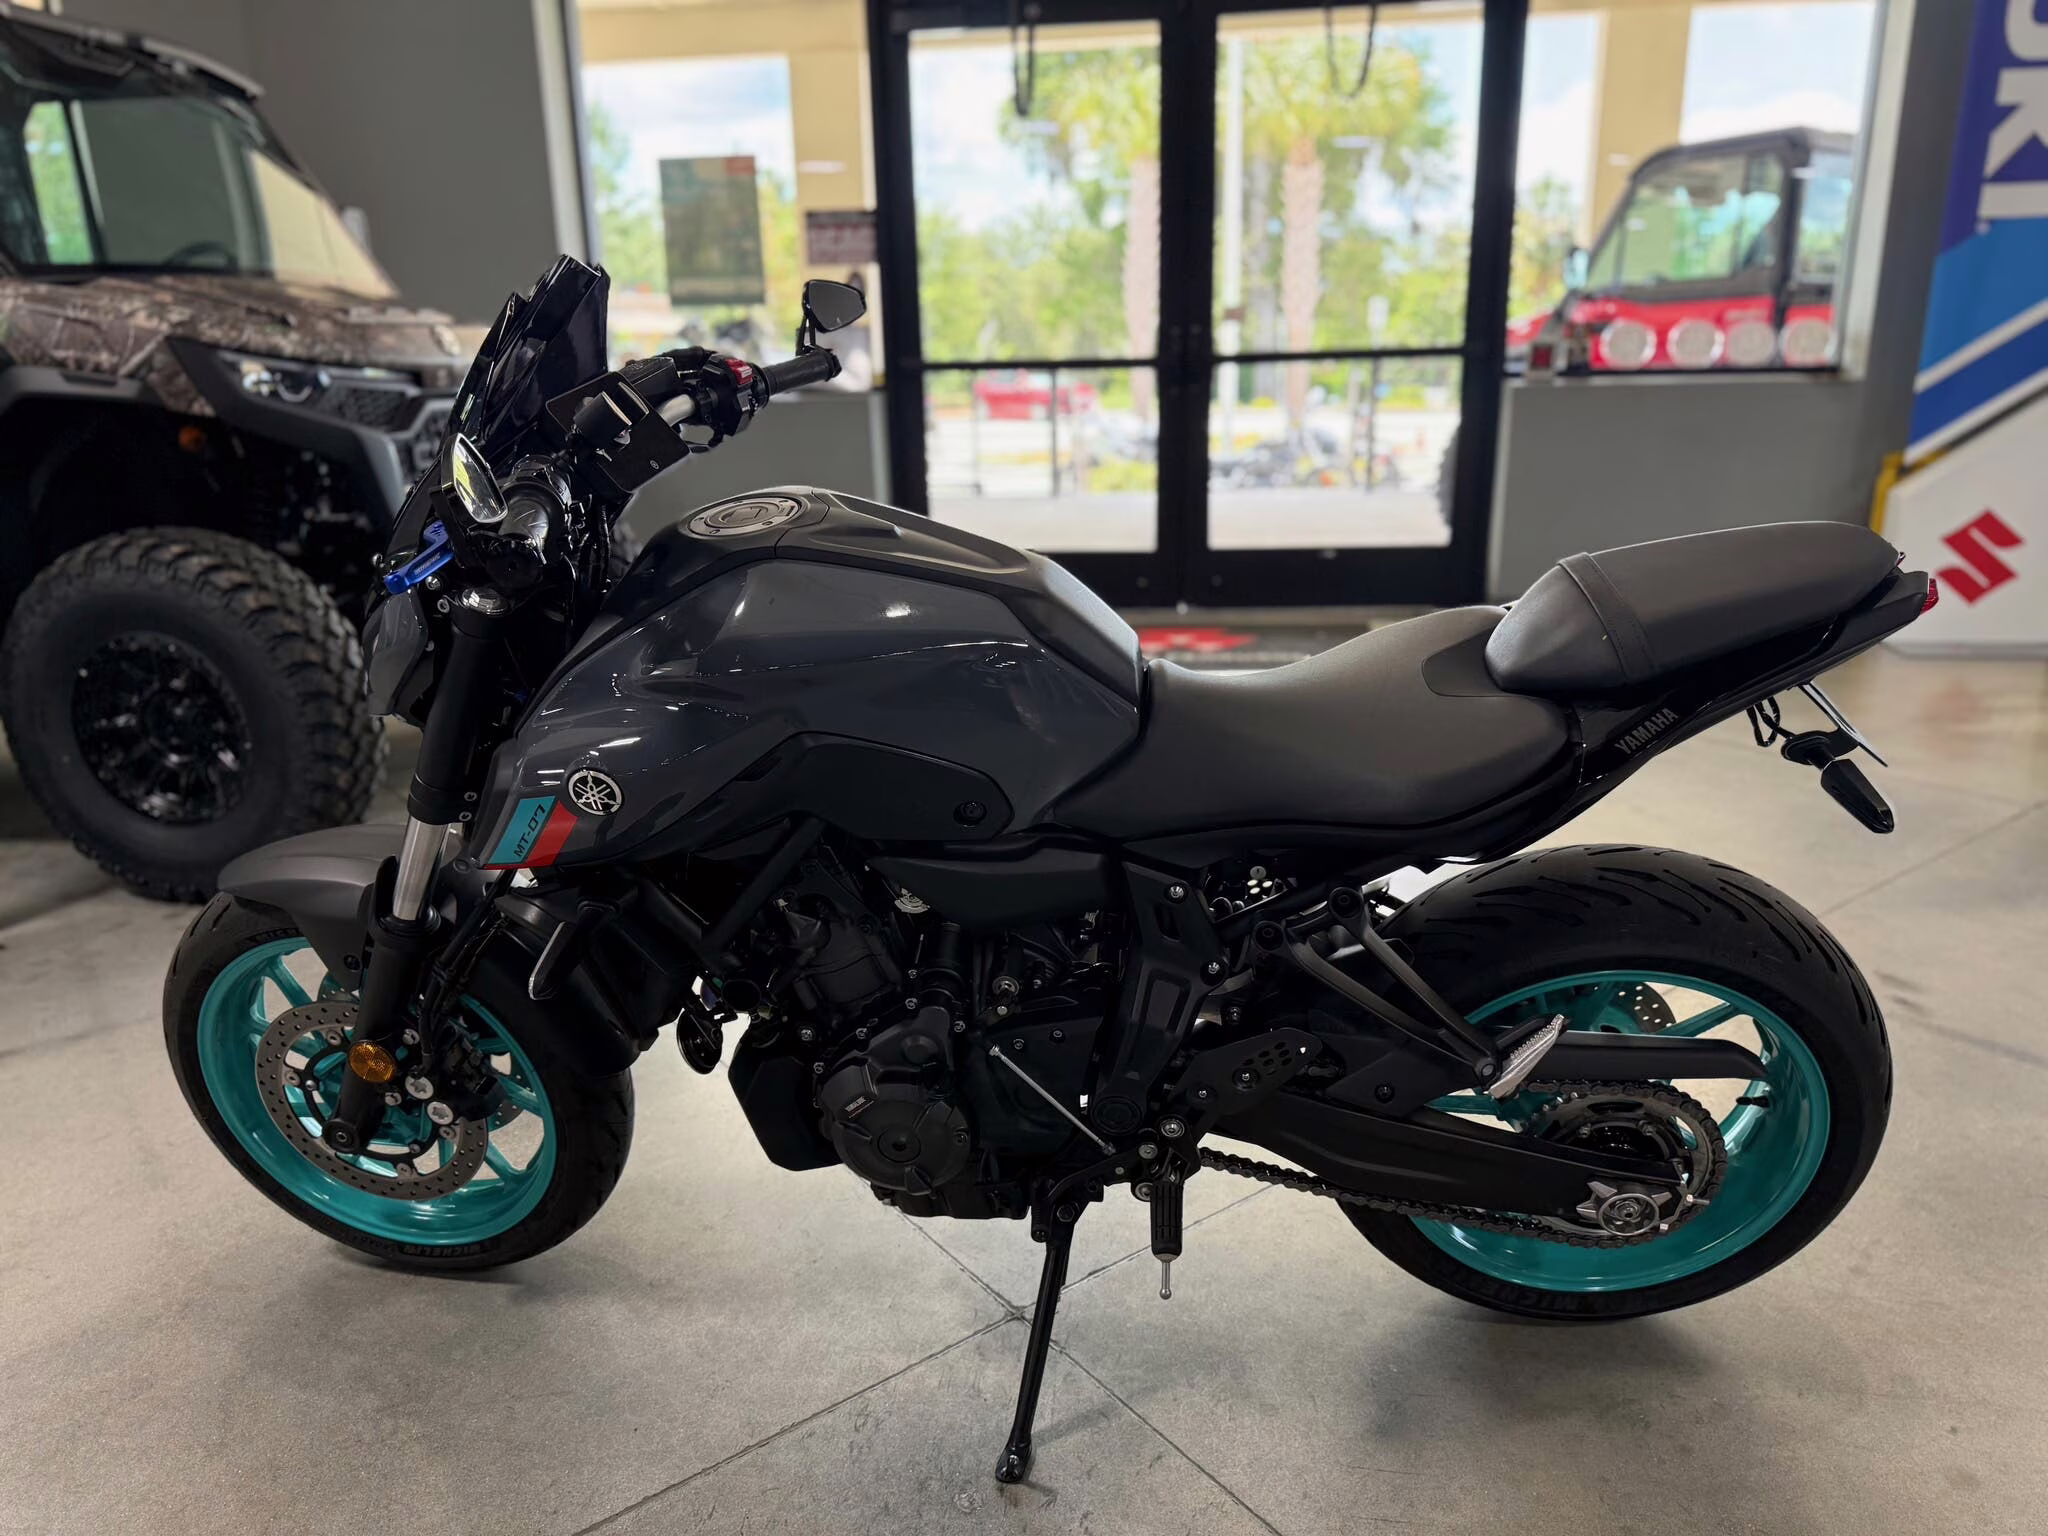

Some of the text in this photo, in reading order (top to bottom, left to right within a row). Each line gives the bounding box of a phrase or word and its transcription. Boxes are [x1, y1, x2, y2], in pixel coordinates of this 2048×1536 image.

[1976, 0, 2048, 219] KI
[1614, 707, 1679, 754] YAMAHA
[513, 803, 546, 857] MT-07
